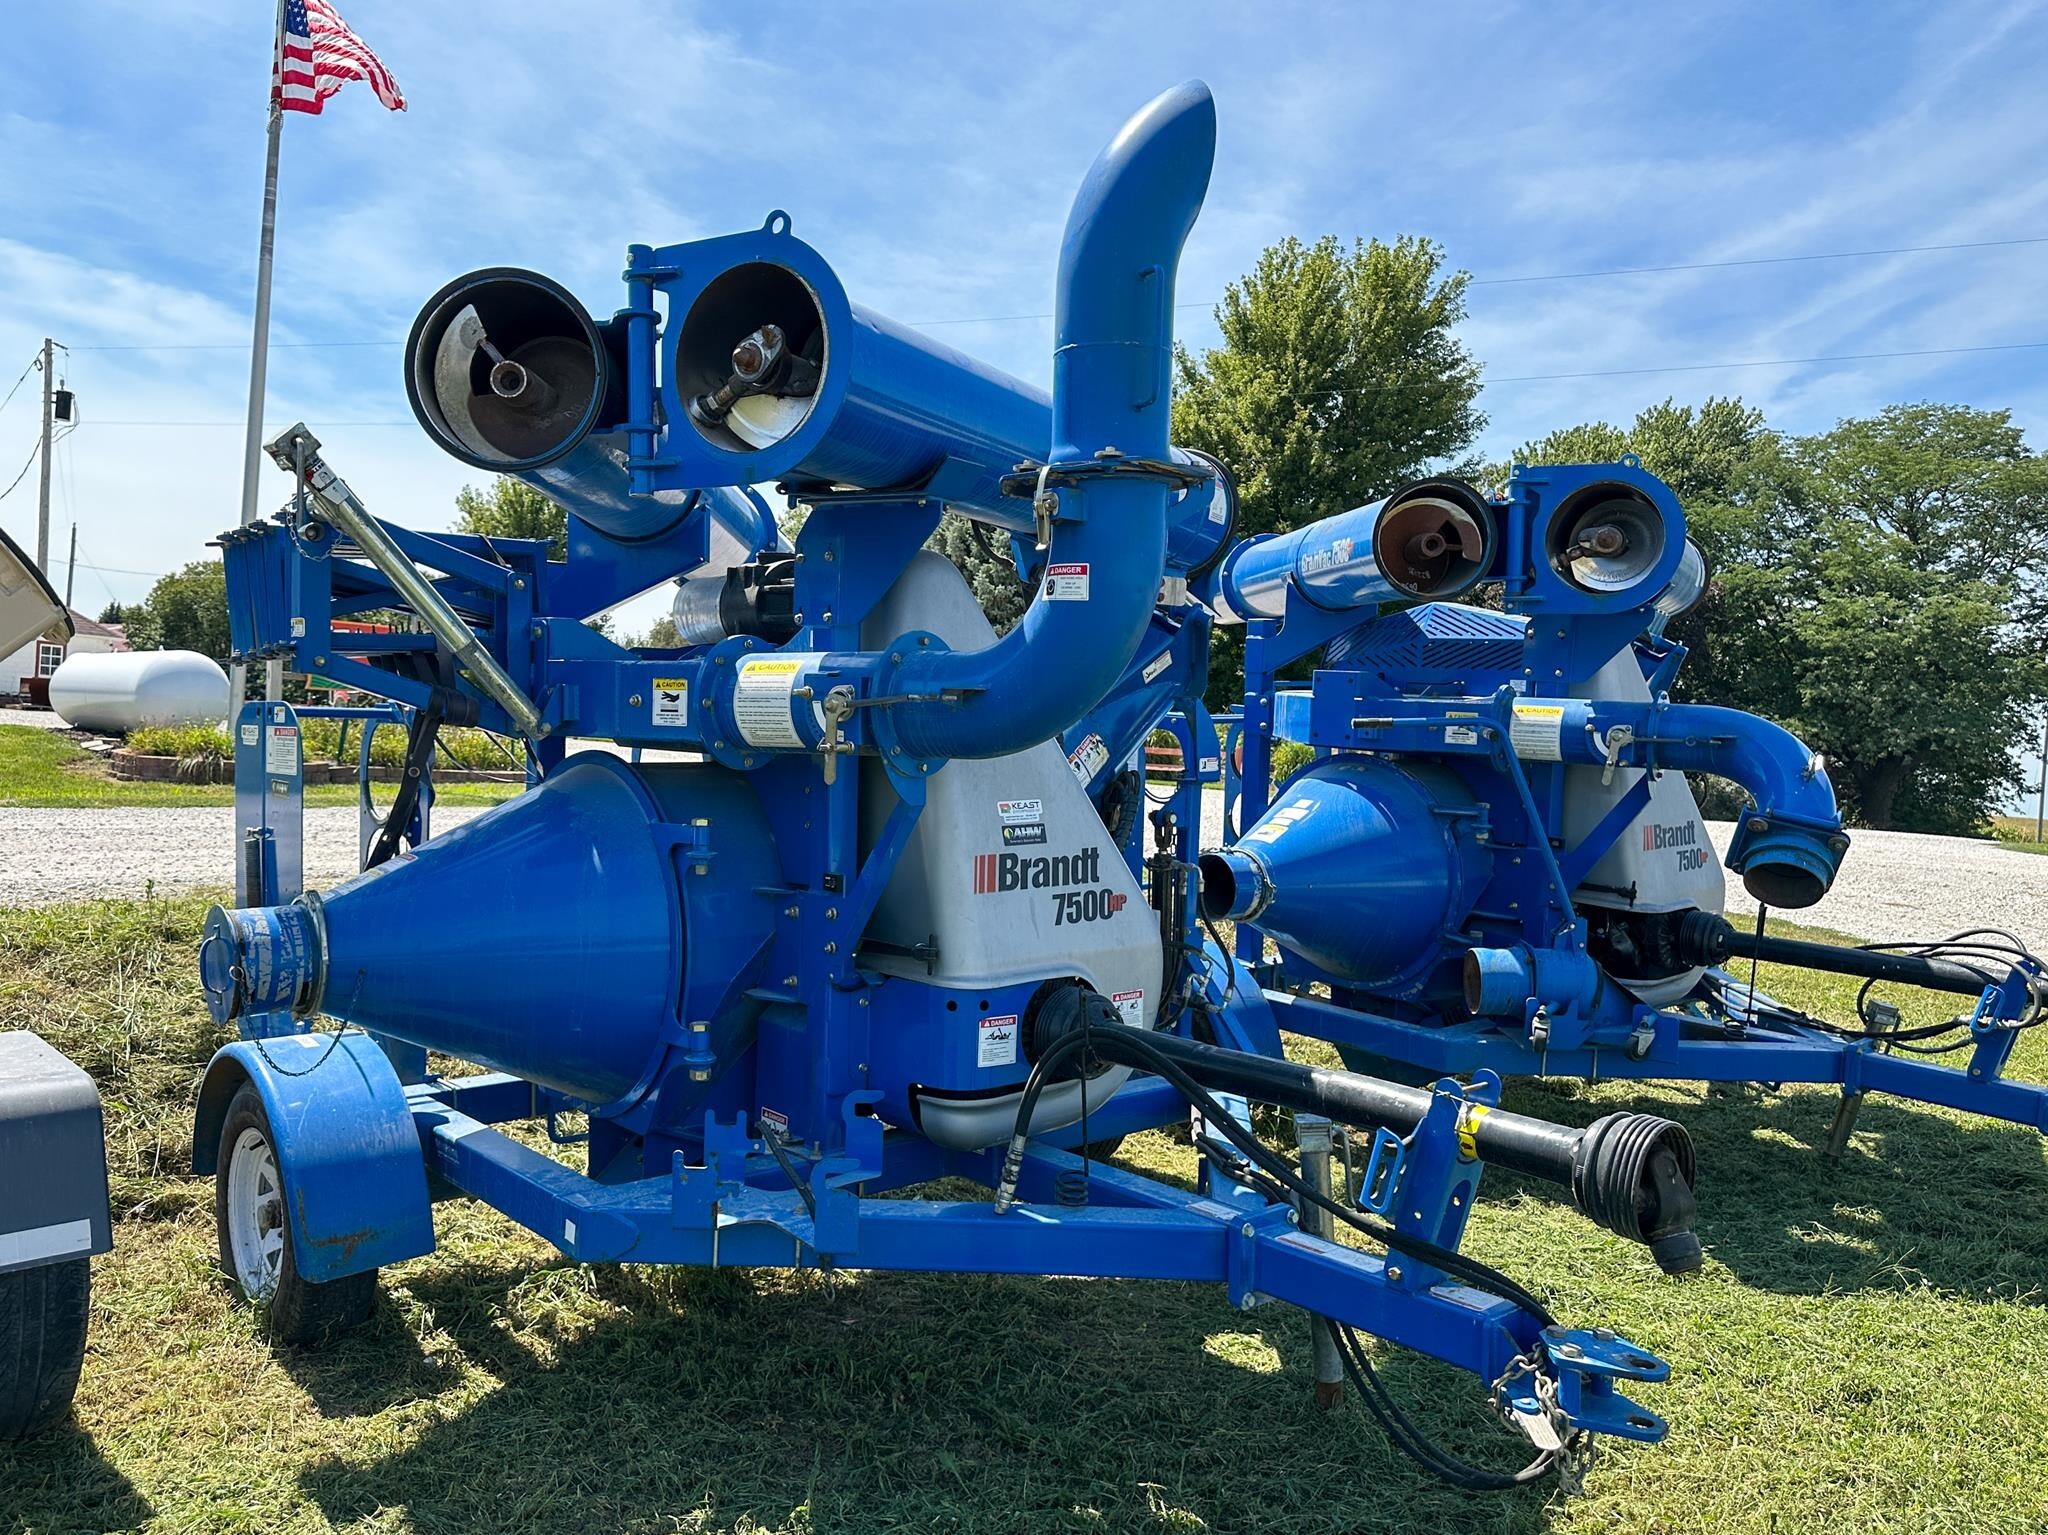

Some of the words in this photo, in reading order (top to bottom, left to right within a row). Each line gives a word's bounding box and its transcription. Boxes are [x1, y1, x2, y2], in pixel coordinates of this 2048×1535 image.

[1054, 566, 1082, 574] DANGER
[758, 663, 797, 671] CAUTION
[1011, 801, 1040, 810] KEAST
[1013, 826, 1042, 839] AHW
[1654, 820, 1696, 850] Brandt
[998, 847, 1100, 892] Brandt
[1120, 991, 1140, 1000] DANGER
[990, 1018, 1013, 1026] DANGER
